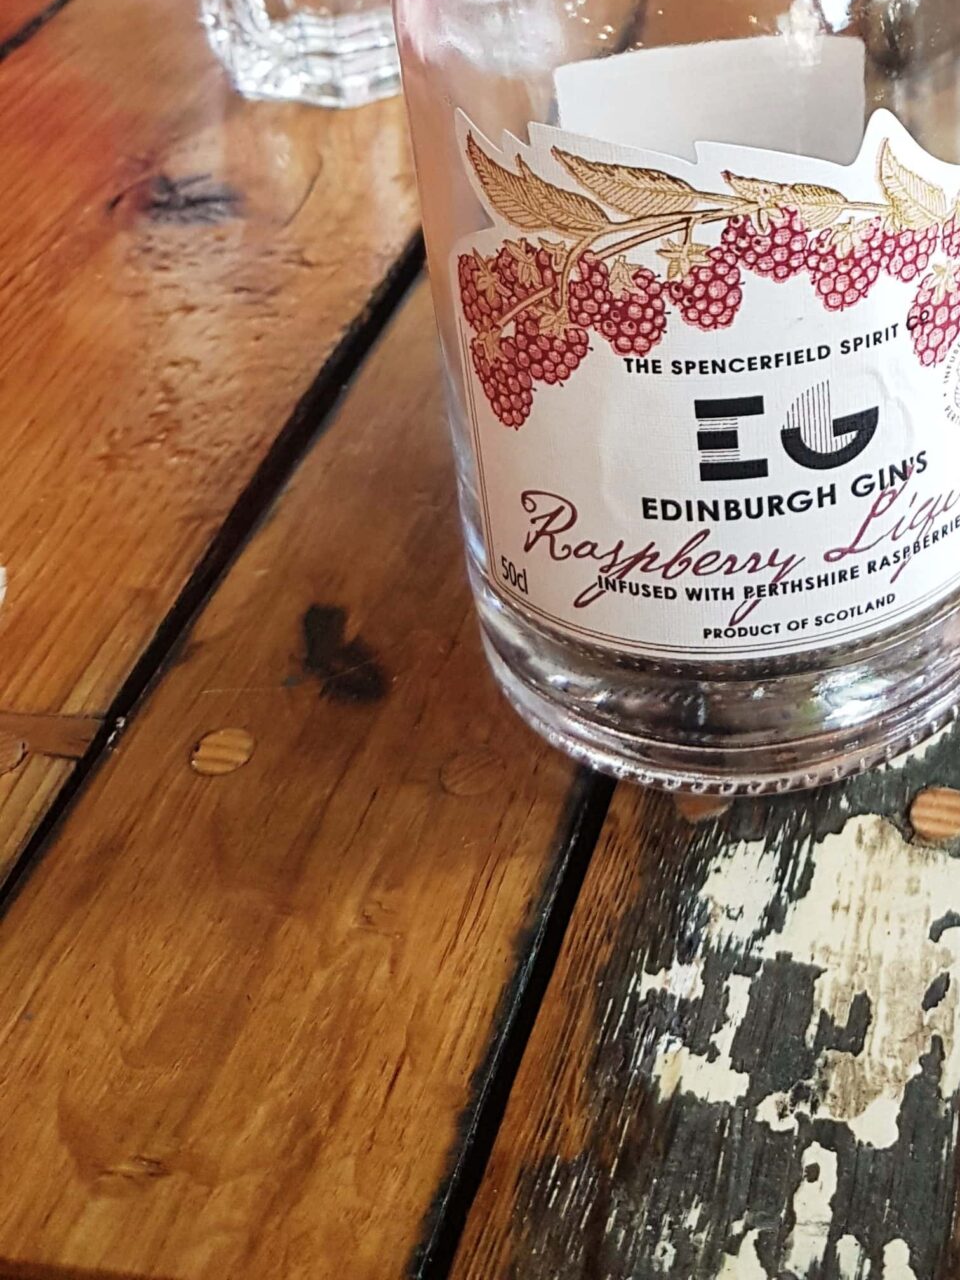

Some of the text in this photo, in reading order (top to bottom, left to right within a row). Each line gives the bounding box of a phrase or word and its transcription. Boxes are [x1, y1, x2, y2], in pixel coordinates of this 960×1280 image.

[623, 357, 663, 375] THE
[671, 344, 832, 375] SPENCERFIELD
[840, 323, 899, 355] SPIRIT
[694, 379, 880, 482] EG
[641, 450, 928, 522] EDINBURGH GIN'S
[500, 555, 529, 595] 50cl
[520, 489, 806, 627] Raspberry
[597, 574, 678, 600] INFUSED
[685, 586, 735, 602] WITH
[743, 564, 860, 601] PERTHSHIRE
[703, 593, 896, 640] PRODUCT OF SCOTLAND
